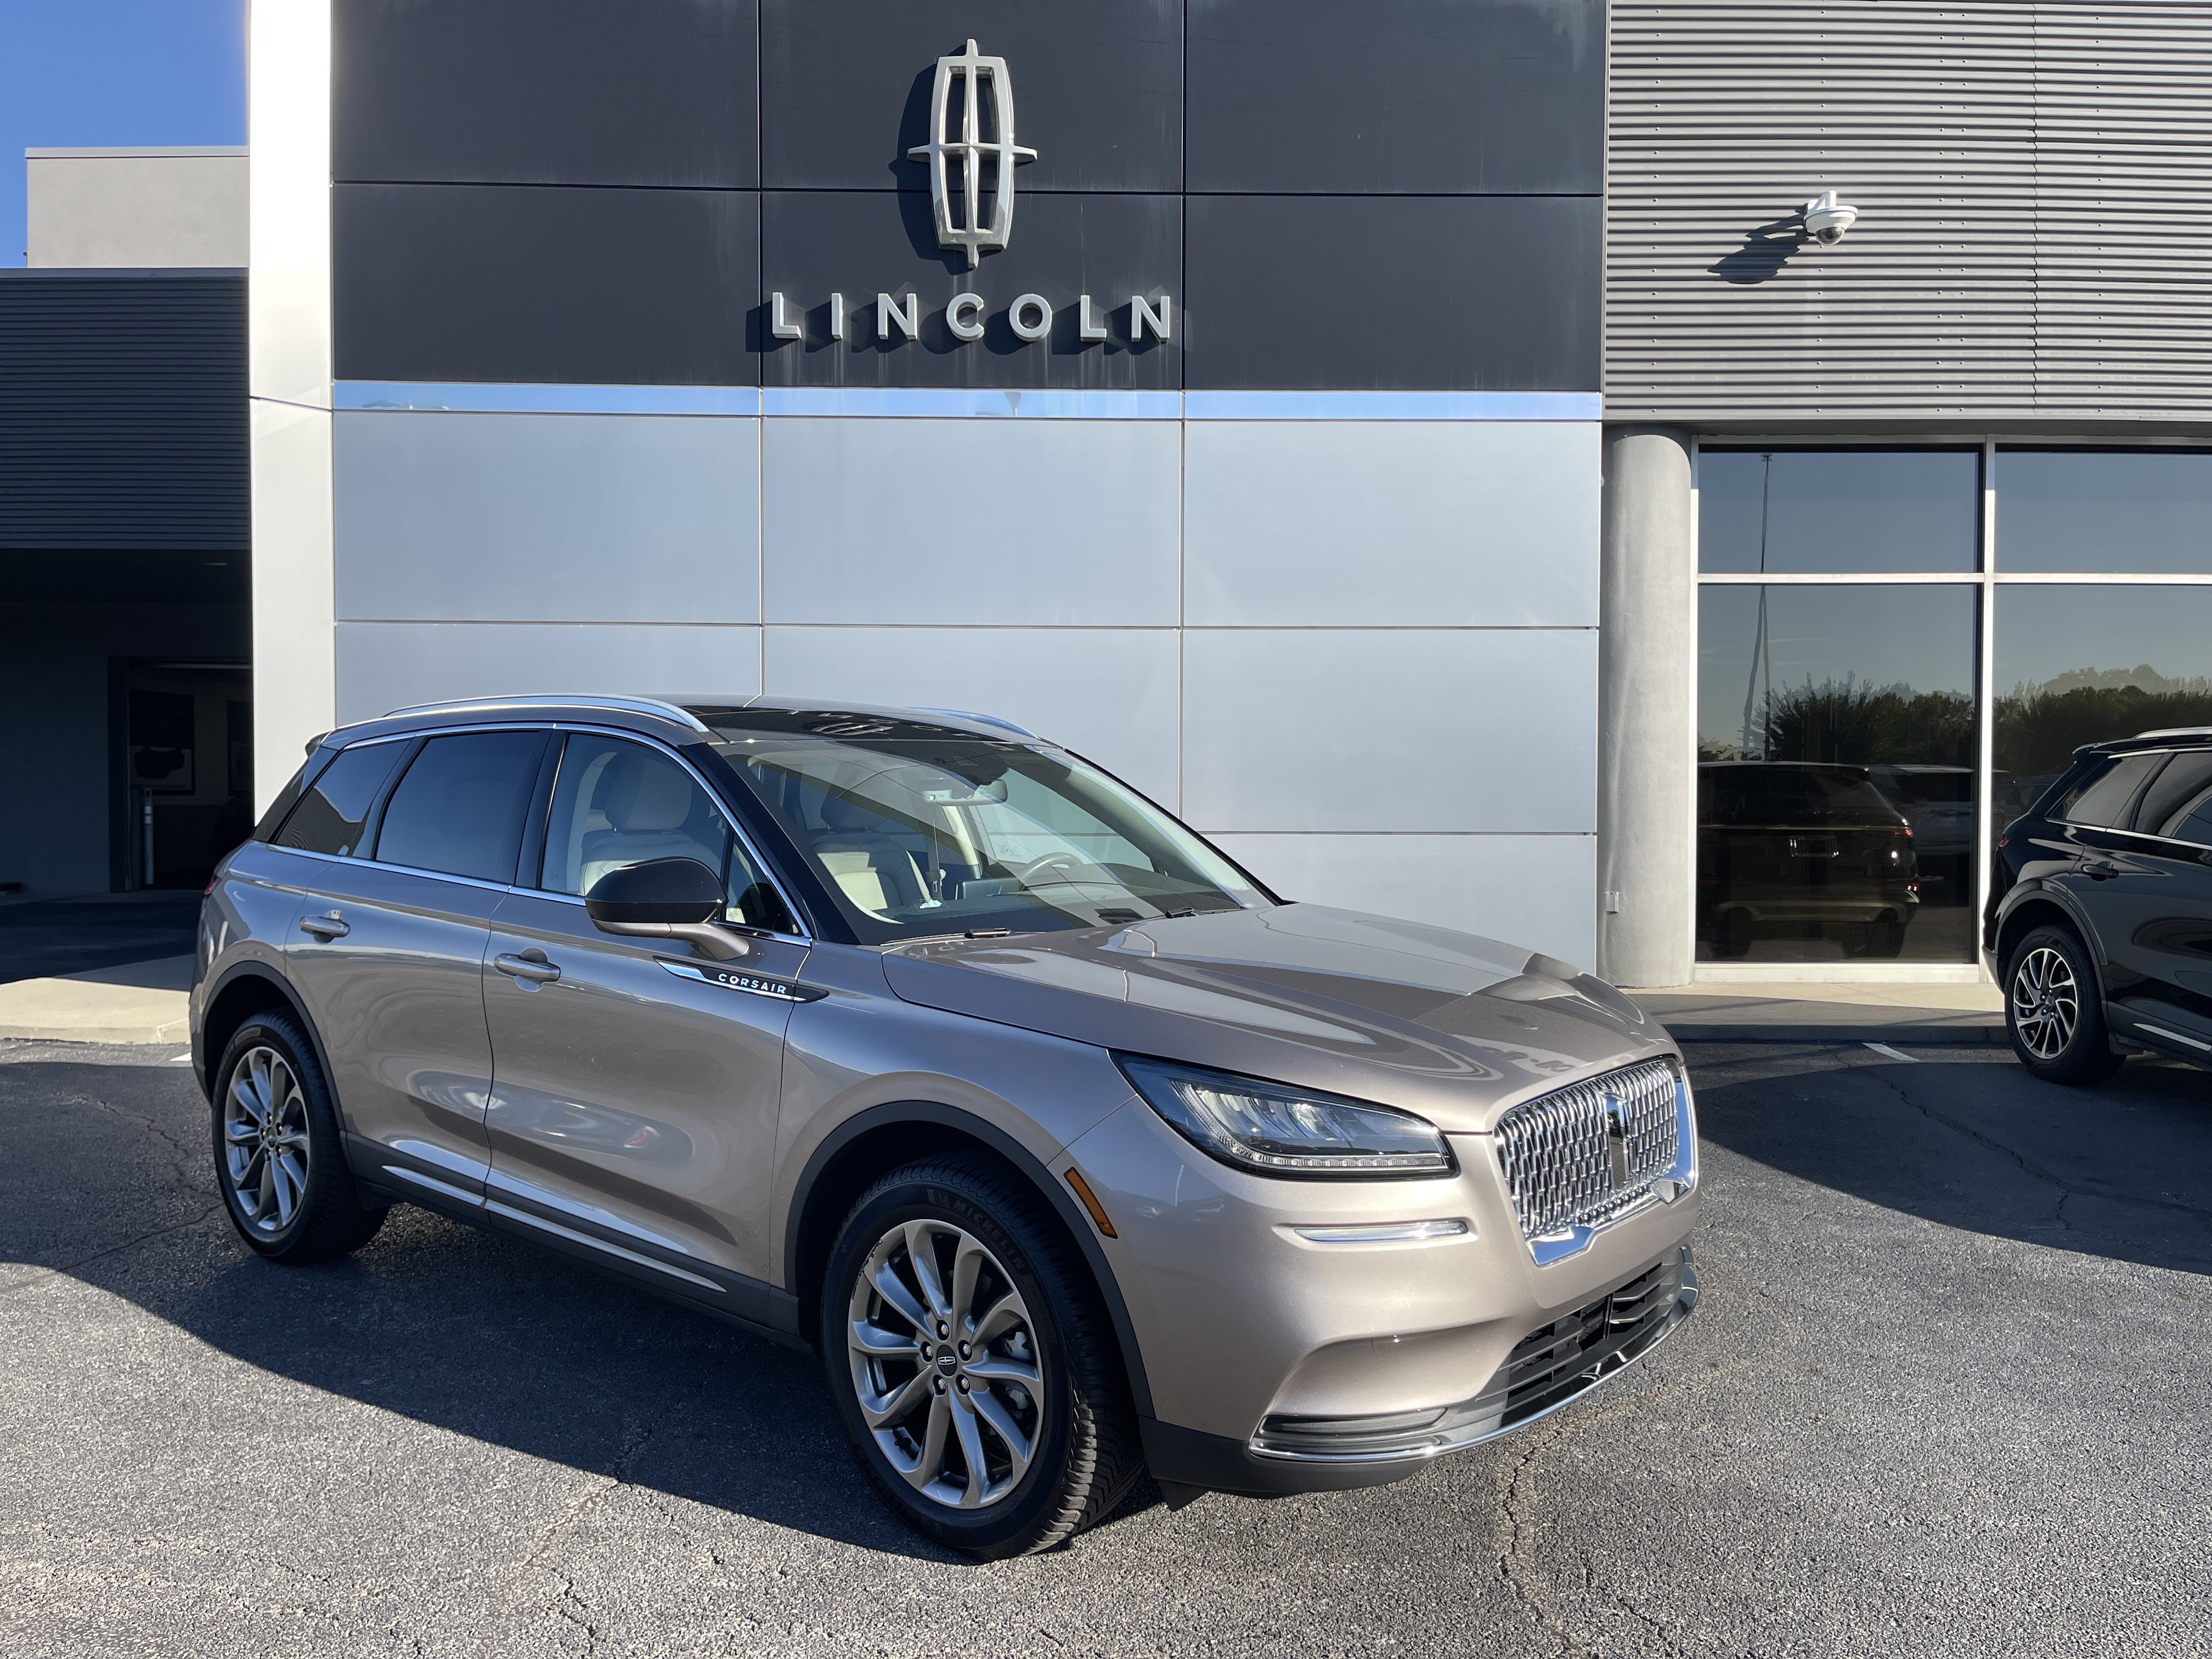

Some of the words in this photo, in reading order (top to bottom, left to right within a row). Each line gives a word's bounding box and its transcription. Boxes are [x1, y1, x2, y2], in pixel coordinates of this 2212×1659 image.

[771, 291, 1171, 343] LINCOLN
[718, 973, 787, 995] CORSAIR
[953, 1199, 1026, 1270] MICHELIN
